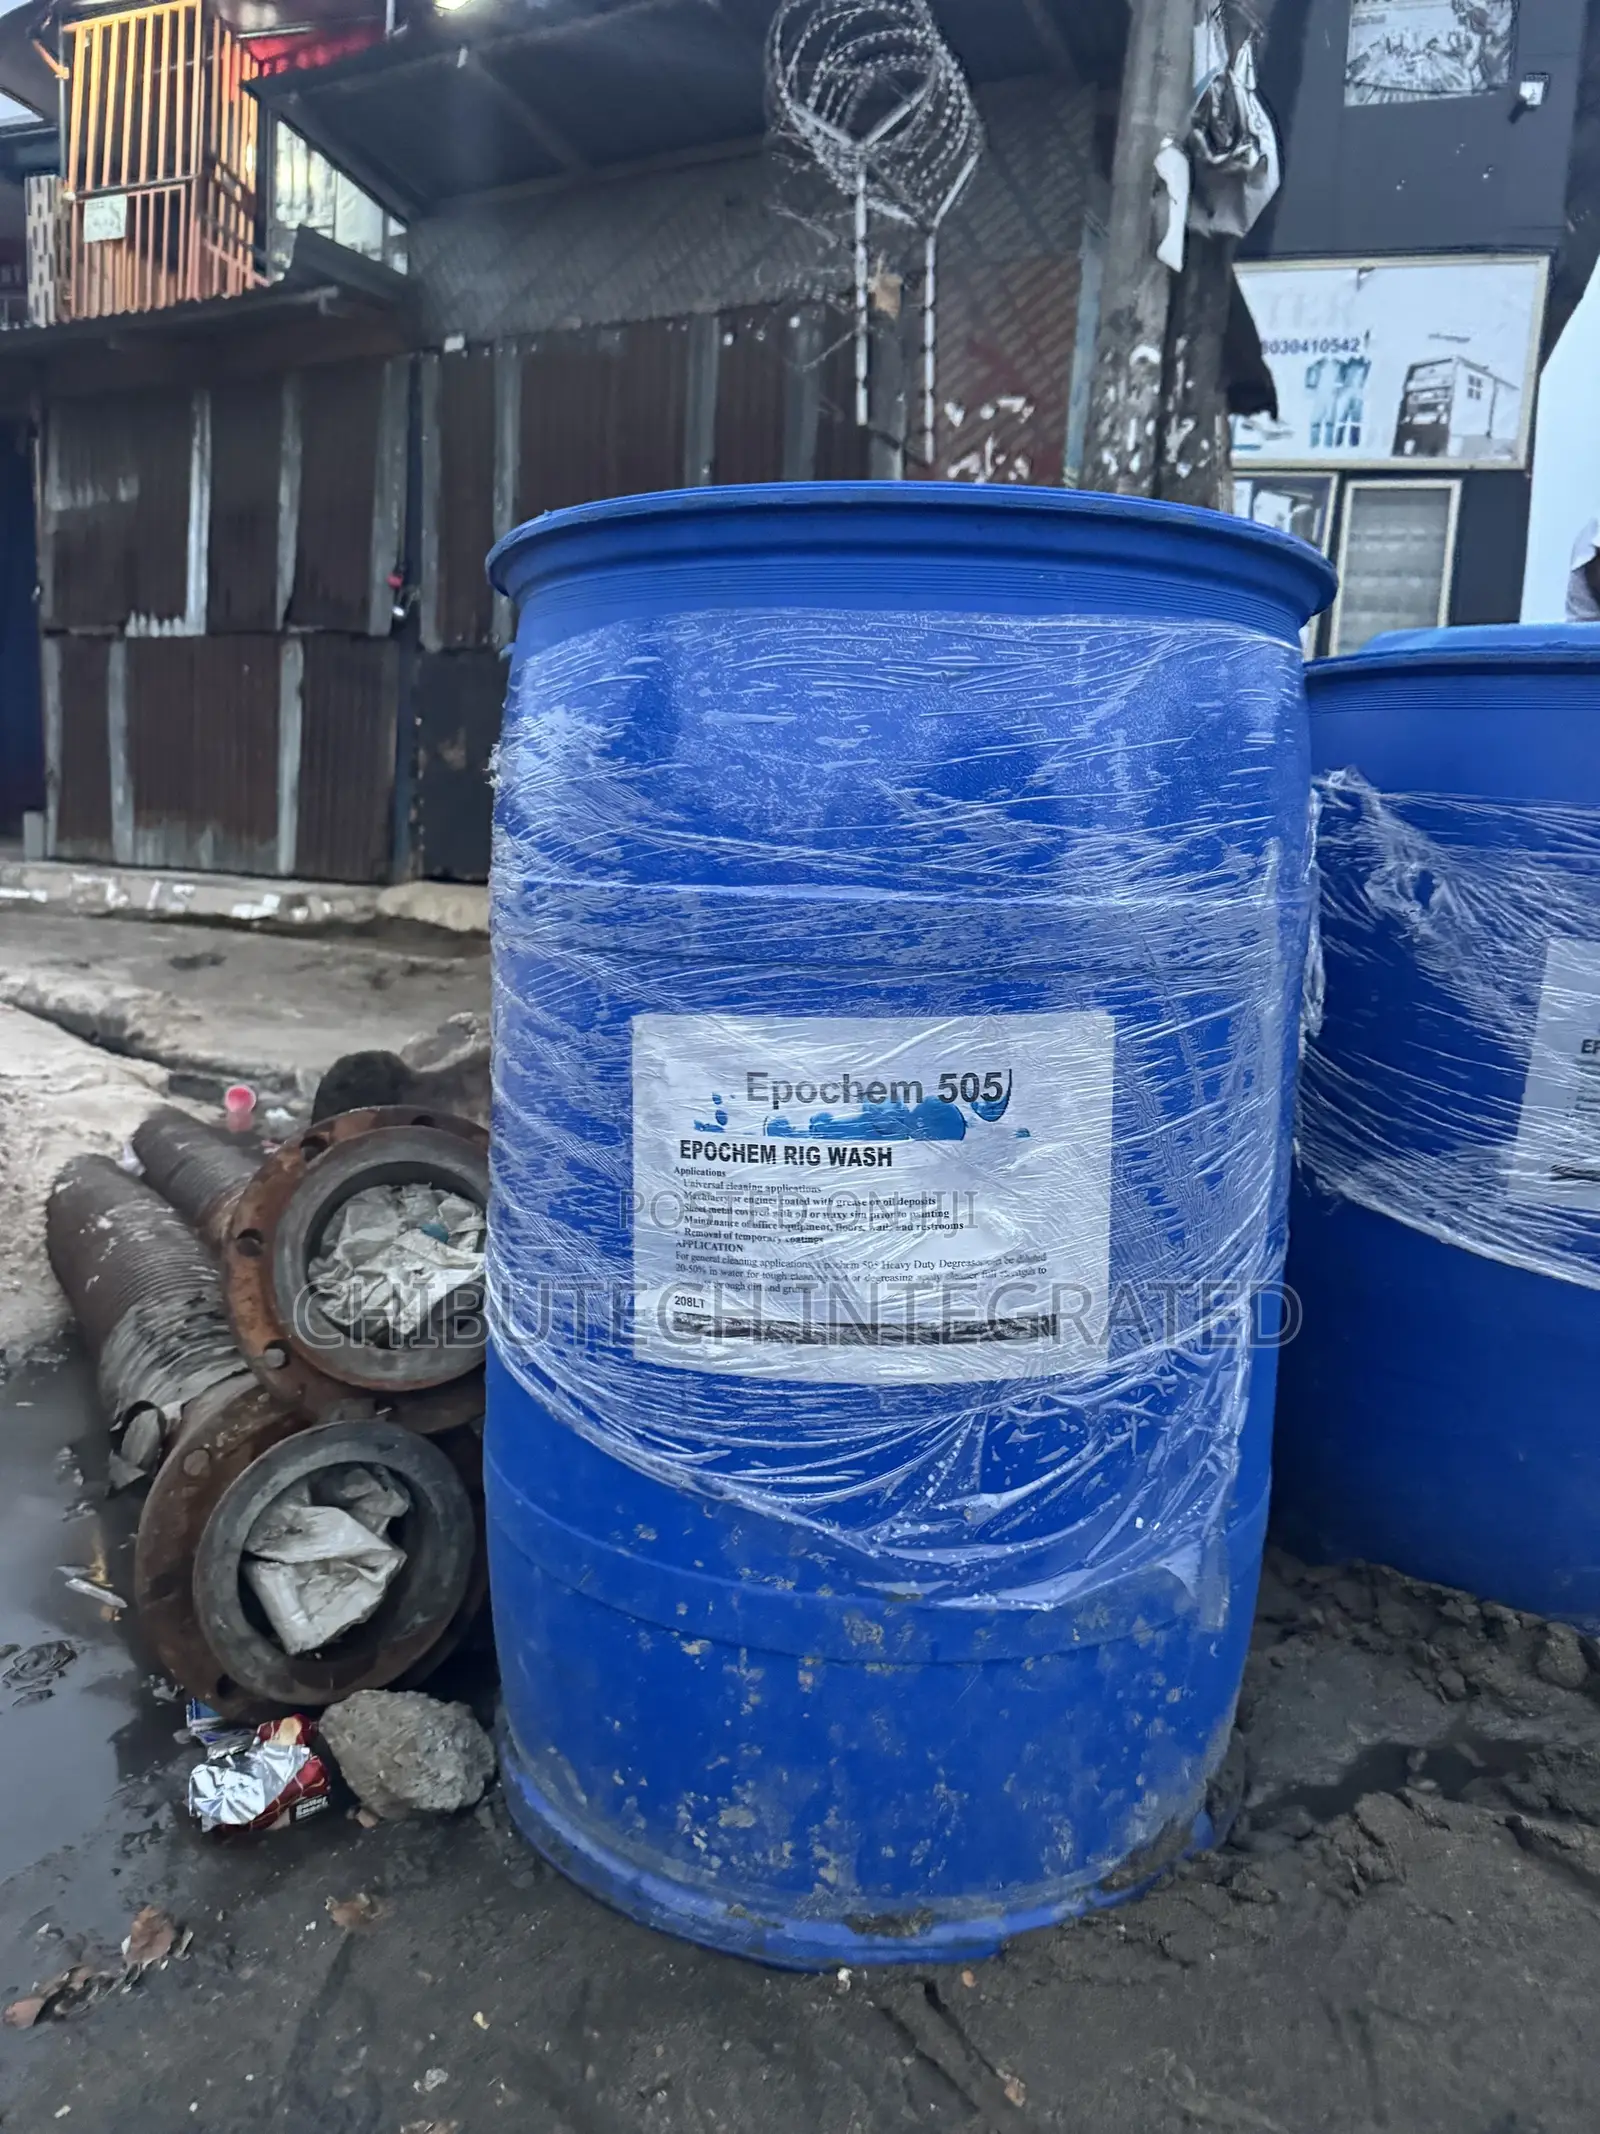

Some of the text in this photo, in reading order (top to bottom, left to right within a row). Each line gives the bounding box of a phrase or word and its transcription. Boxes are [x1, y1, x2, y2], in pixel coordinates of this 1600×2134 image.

[746, 1071, 1003, 1110] Epochem 505
[680, 1139, 893, 1167] EPOCHEM RIG WASH
[674, 1166, 726, 1178] Applications
[683, 1178, 821, 1194] Universal cleaning applications
[744, 1195, 777, 1206] engines
[780, 1195, 810, 1206] coated
[813, 1196, 833, 1206] with
[836, 1198, 867, 1208] grease
[869, 1198, 878, 1207] or
[883, 1196, 895, 1206] oil
[899, 1196, 936, 1208] deposits
[708, 1204, 733, 1215] metal
[734, 1206, 770, 1217] covered
[810, 1210, 820, 1218] or
[870, 1209, 894, 1221] prior
[910, 1209, 949, 1220] painting
[684, 1215, 739, 1229] Maintenance
[742, 1219, 751, 1229] of
[752, 1220, 777, 1230] office
[916, 1220, 964, 1232] restrooms
[684, 1227, 721, 1240] Removal
[724, 1230, 733, 1240] of
[676, 1239, 744, 1253] APPLICATION
[676, 1251, 688, 1260] For
[690, 1253, 720, 1265] general
[722, 1256, 757, 1269] cleaning
[881, 1259, 910, 1271] Heavy
[913, 1258, 936, 1271] Duty
[709, 1266, 718, 1276] in
[720, 1268, 744, 1278] water
[747, 1269, 760, 1280] for
[762, 1270, 787, 1282] tough
[852, 1274, 862, 1282] or
[1038, 1266, 1047, 1275] to
[674, 1295, 706, 1309] 208LT
